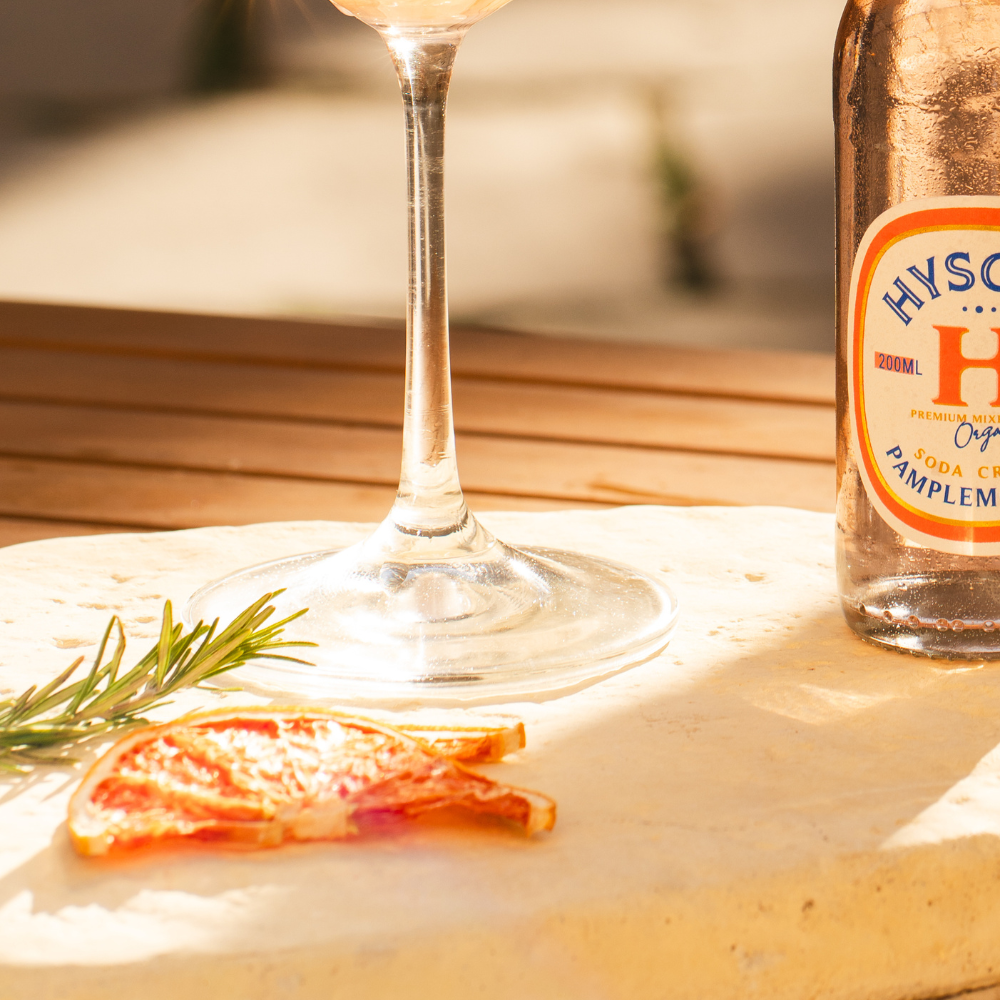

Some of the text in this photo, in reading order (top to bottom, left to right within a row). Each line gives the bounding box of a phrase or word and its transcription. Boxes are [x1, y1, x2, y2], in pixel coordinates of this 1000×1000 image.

[878, 353, 923, 375] 200ML
[910, 408, 967, 424] PREMIUM
[913, 447, 963, 478] SODA
